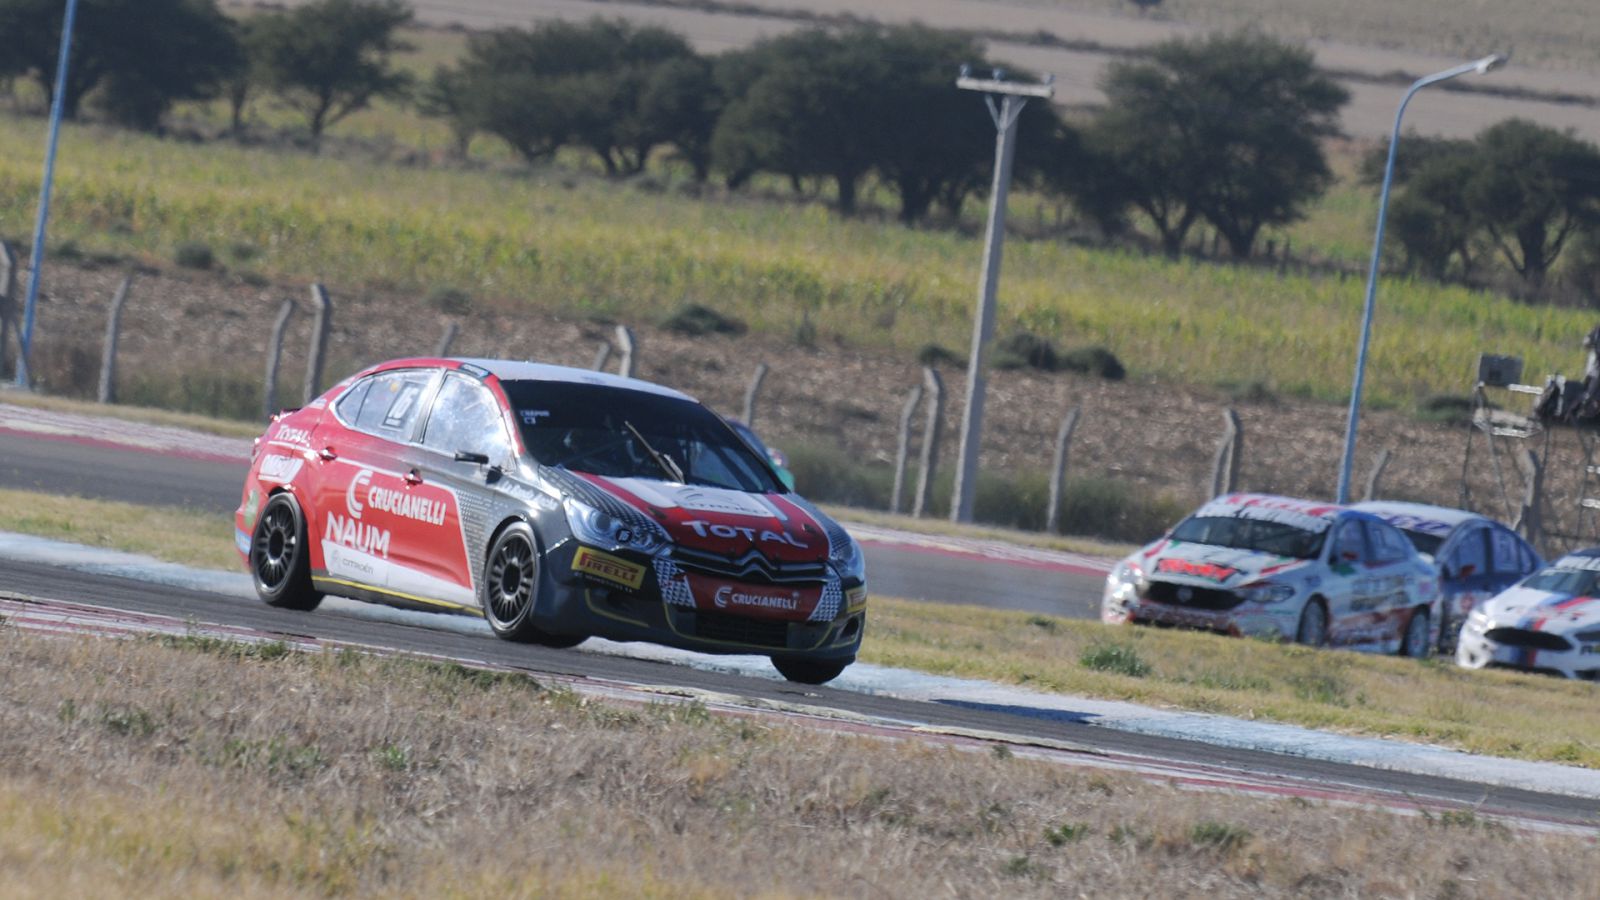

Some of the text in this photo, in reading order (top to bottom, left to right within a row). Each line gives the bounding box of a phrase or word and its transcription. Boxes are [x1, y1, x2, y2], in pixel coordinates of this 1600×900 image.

[274, 424, 309, 443] TOTAL
[368, 485, 447, 526] CRUCIANELLI
[325, 511, 391, 559] NAUM
[681, 520, 808, 548] TOTAL
[579, 552, 639, 582] PIRELLI
[731, 593, 798, 610] CRUCIANELLI
